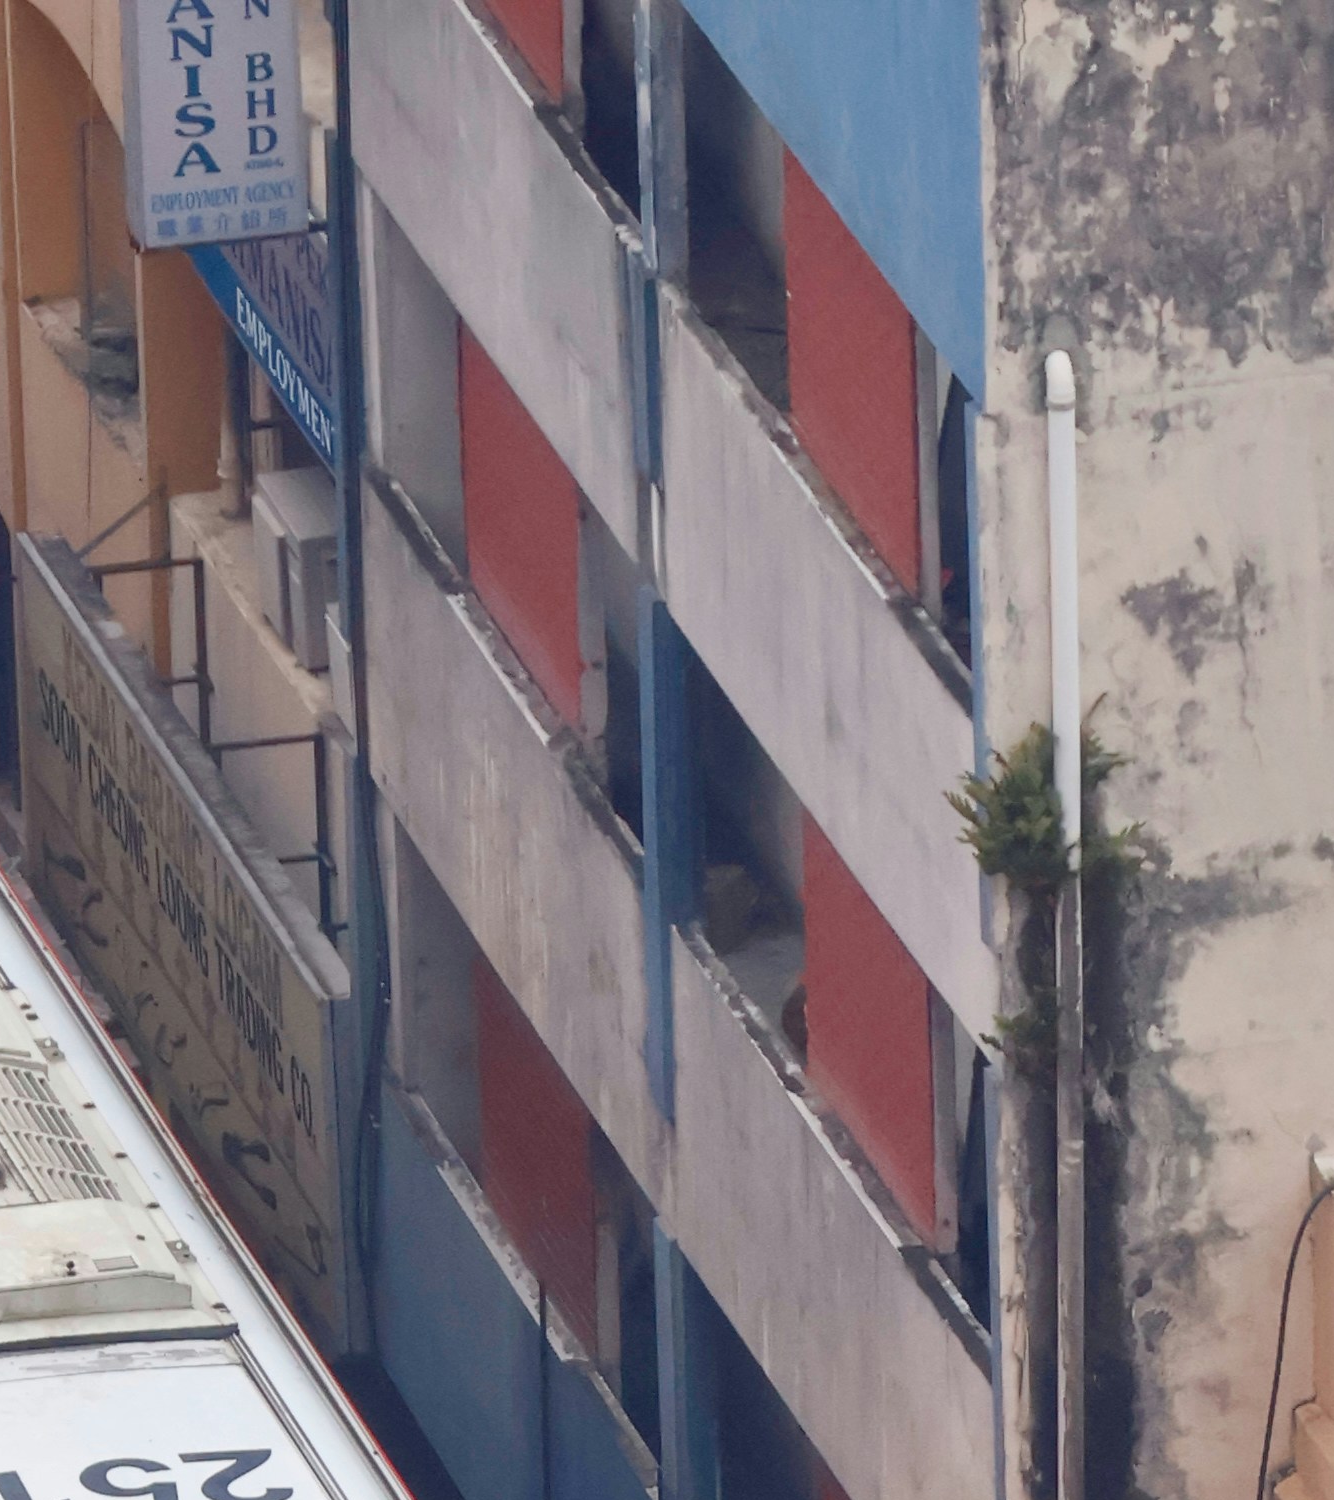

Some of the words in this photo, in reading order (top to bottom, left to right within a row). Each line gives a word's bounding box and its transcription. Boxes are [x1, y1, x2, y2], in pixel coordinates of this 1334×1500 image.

[245, 53, 278, 155] BHD
[150, 185, 240, 213] EMPLOYMENT
[244, 177, 296, 204] AGENCY
[236, 286, 335, 456] EMPLOYMEN
[37, 666, 83, 783] SOON
[88, 755, 149, 886] CHEONG
[156, 860, 209, 979] LOONG
[214, 937, 284, 1096] TRADING
